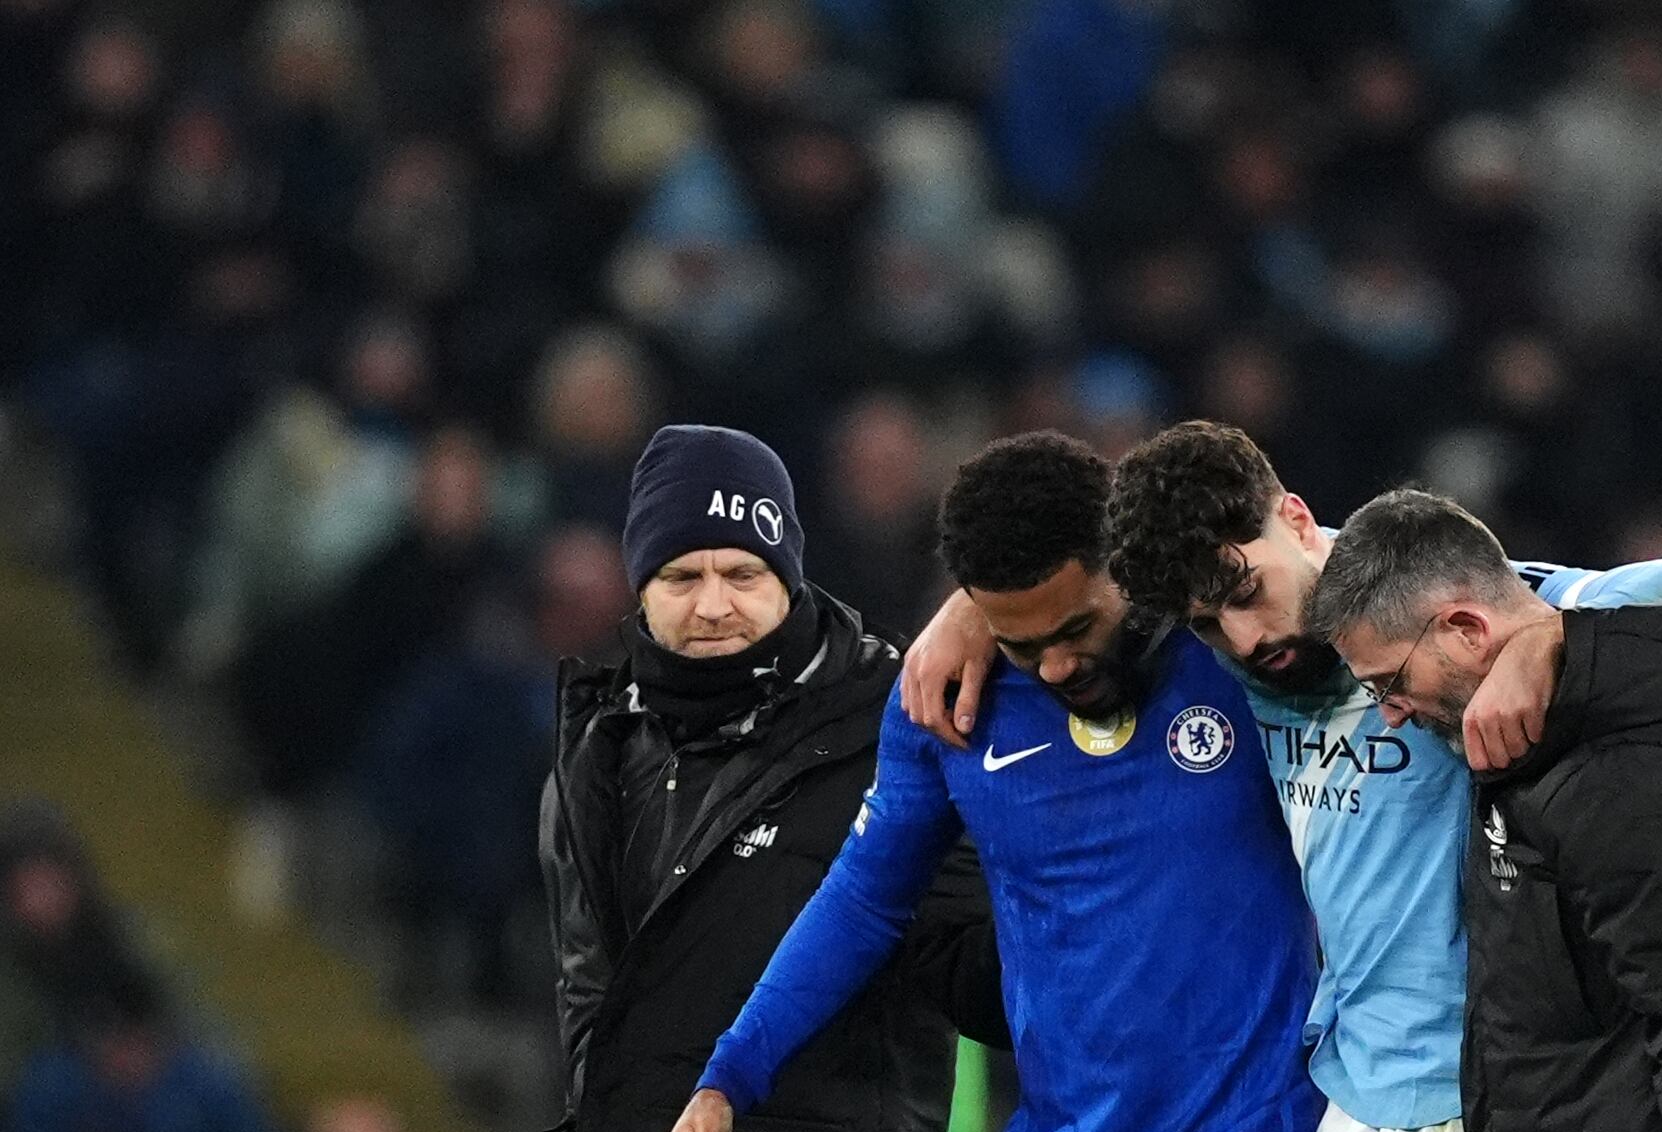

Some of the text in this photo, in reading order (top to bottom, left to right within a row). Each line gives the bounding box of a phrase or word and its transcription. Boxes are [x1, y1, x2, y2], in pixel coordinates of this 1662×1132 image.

[707, 490, 745, 522] AG
[1176, 708, 1219, 726] CHELSEA
[1089, 739, 1115, 750] FIFA
[1256, 719, 1411, 774] TIHAD
[1279, 779, 1361, 815] IRWAYS
